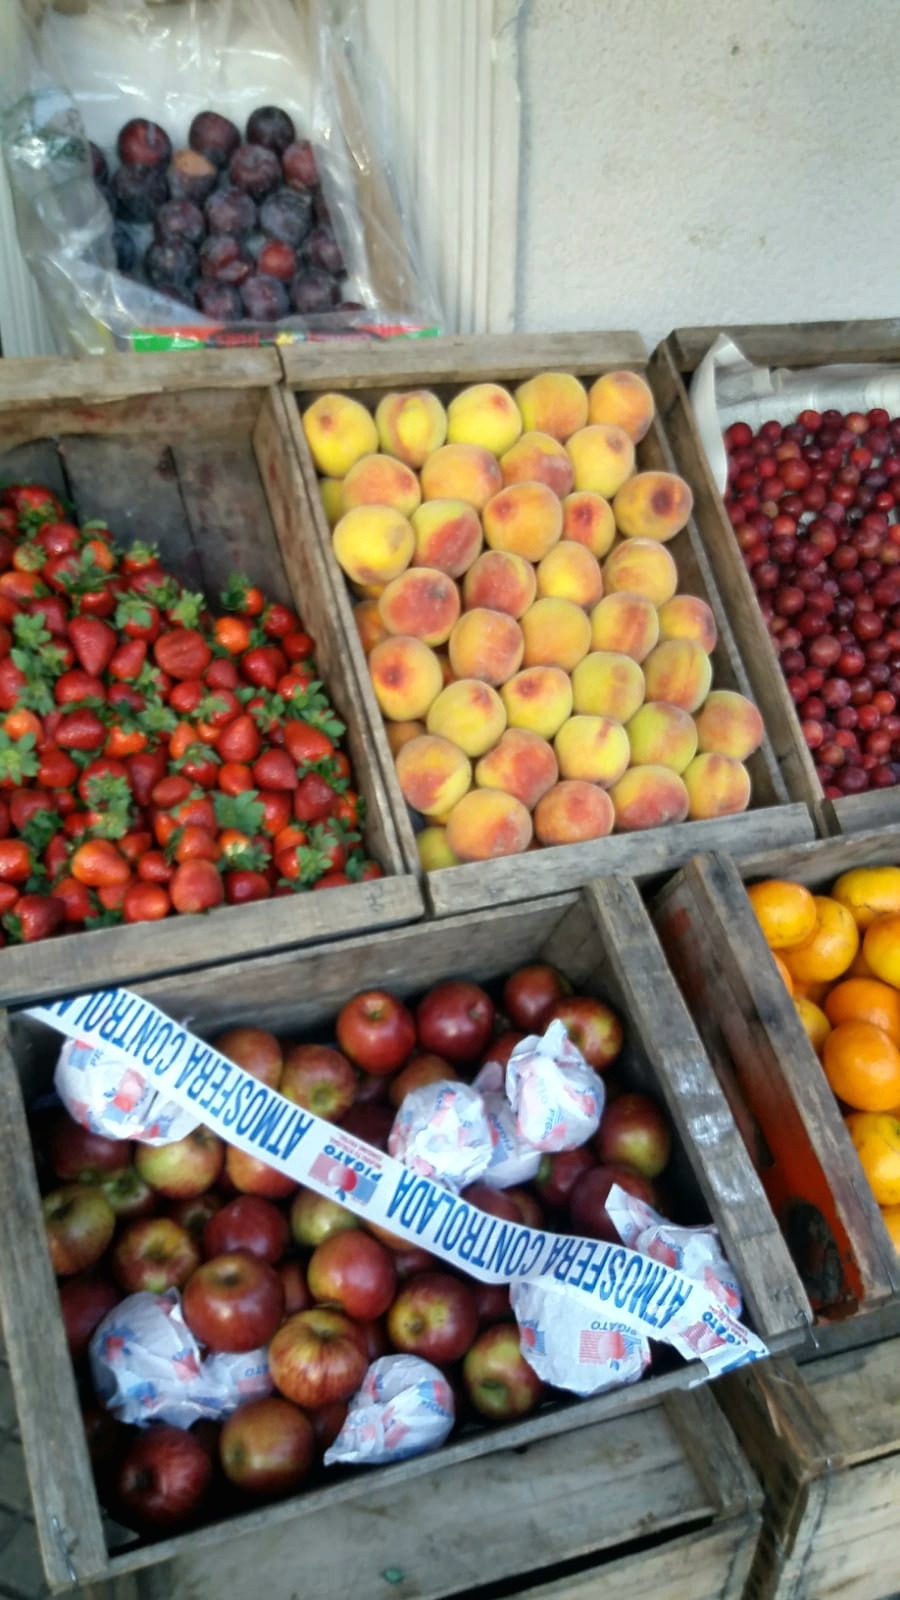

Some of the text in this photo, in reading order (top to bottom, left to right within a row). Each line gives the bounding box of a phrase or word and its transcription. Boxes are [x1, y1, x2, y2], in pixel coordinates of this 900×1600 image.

[41, 989, 314, 1161] ATMOSFERA CONTROL
[323, 1144, 383, 1181] PIGATO
[386, 1166, 694, 1329] ATMOSFERA CONTROLADA
